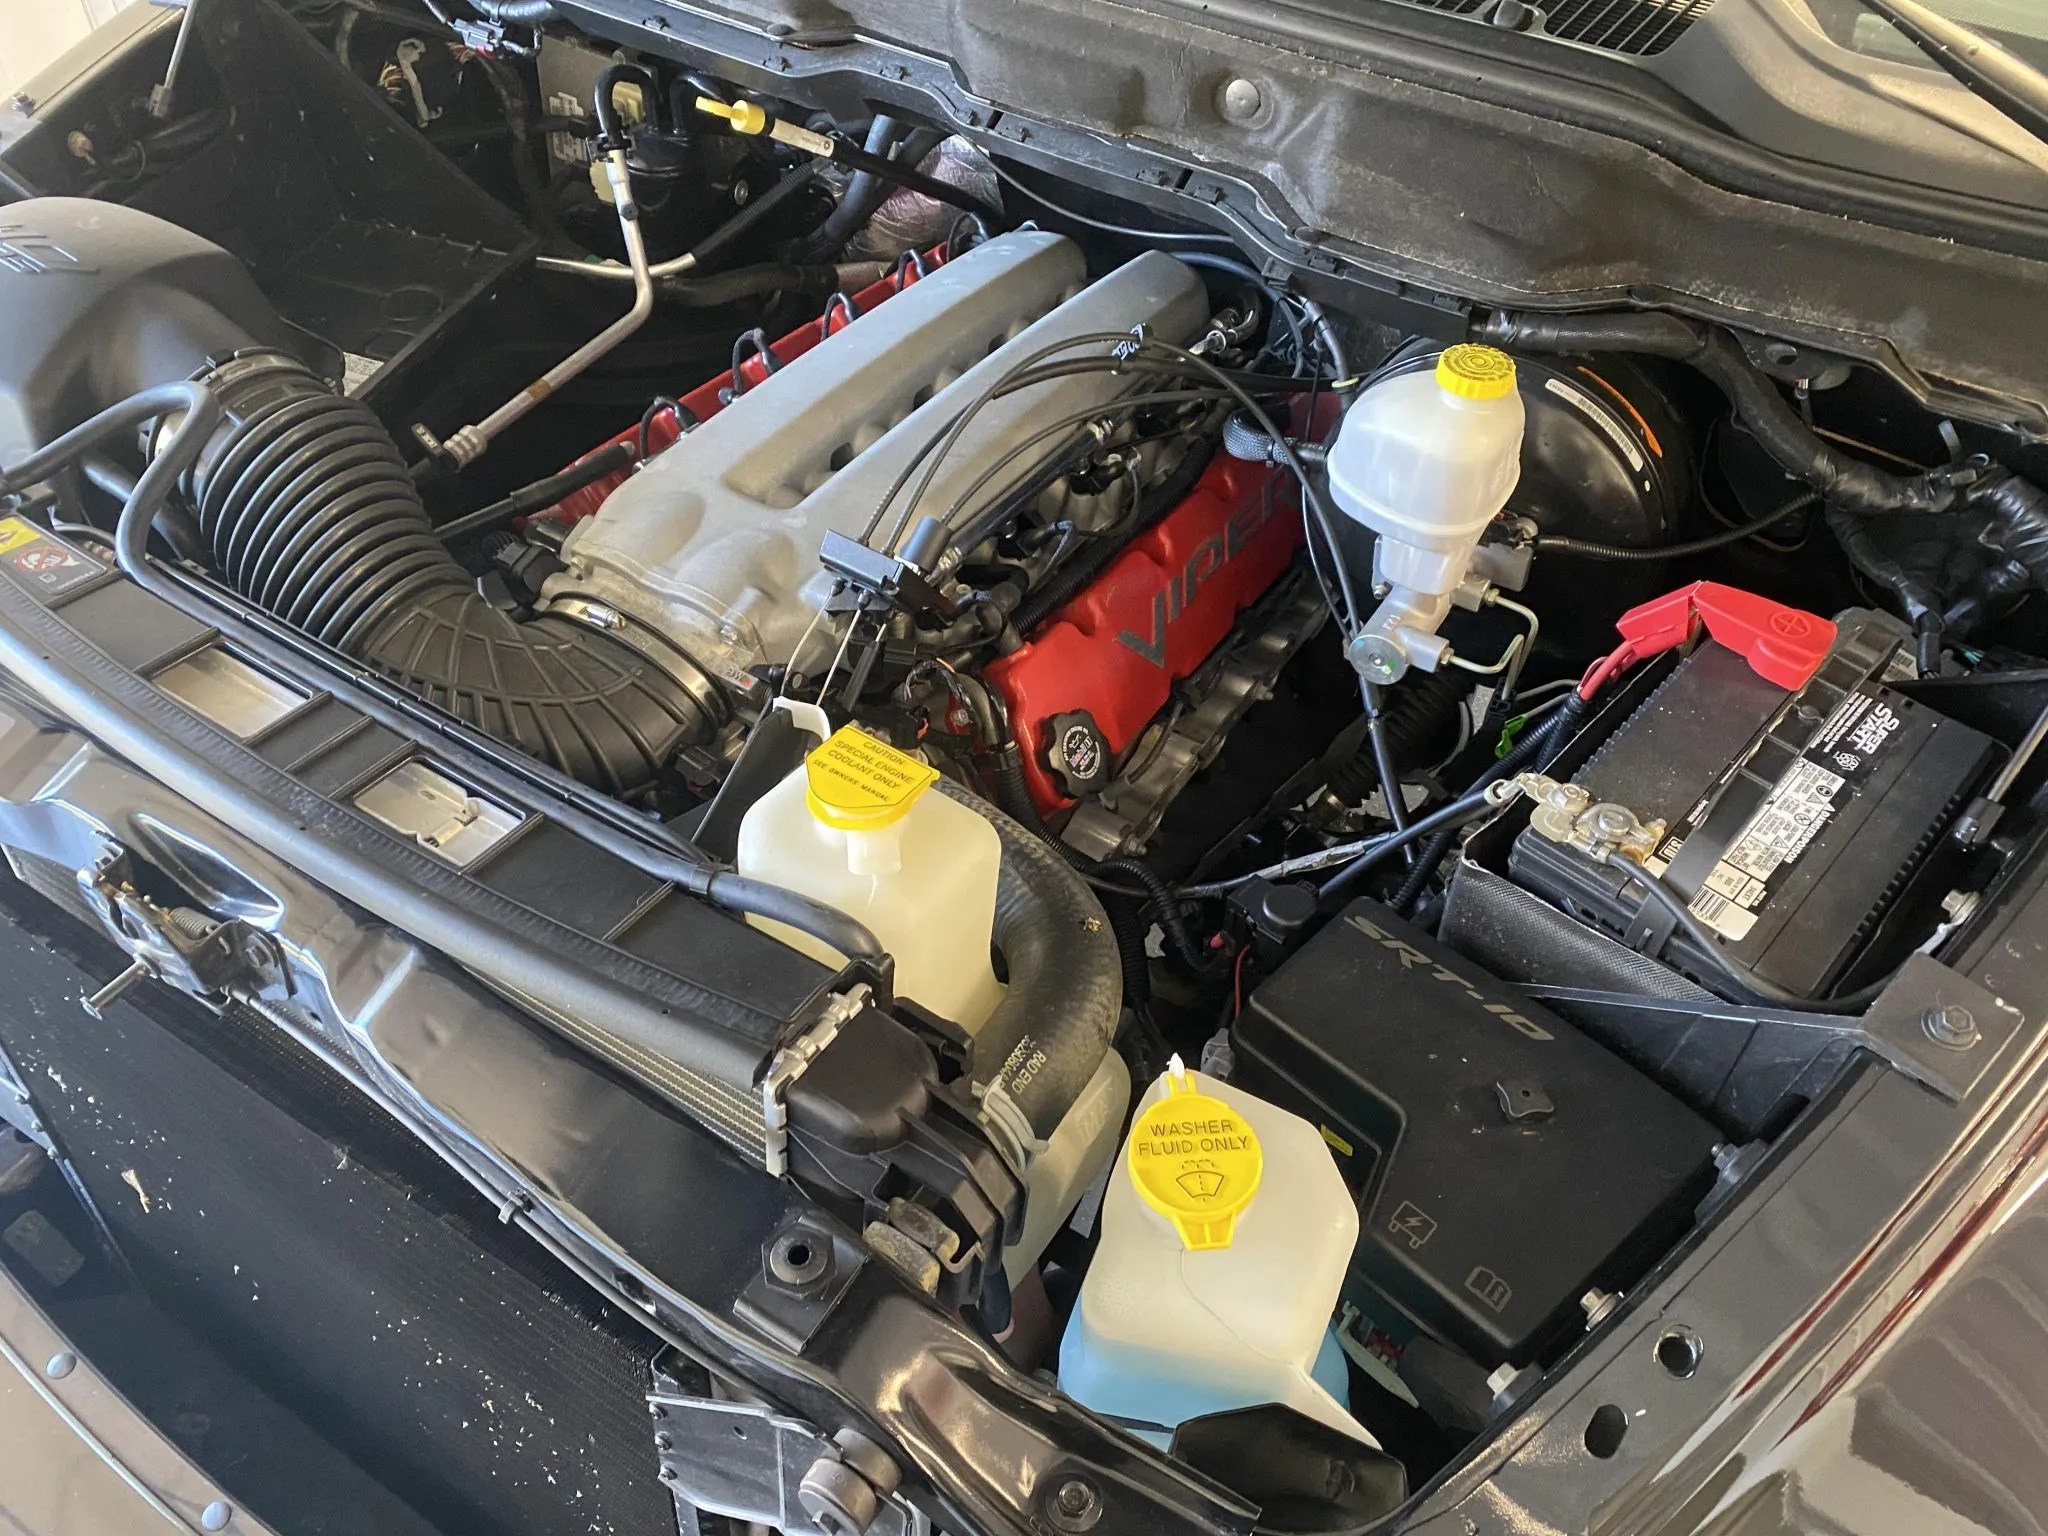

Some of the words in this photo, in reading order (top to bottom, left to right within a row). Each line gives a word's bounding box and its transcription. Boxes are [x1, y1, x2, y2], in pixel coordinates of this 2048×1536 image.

[1112, 464, 1300, 669] VIPER
[1851, 703, 1892, 750] START
[1862, 718, 1900, 754] SUPER
[827, 749, 873, 777] COOLANT
[873, 769, 901, 789] ONLY
[834, 740, 873, 764] SPECIAL
[874, 761, 915, 784] ENGINE
[863, 741, 905, 766] CAUTION
[812, 759, 827, 769] SEE
[860, 784, 890, 802] MANUAL
[1344, 916, 1555, 1040] SRT-10
[1011, 1068, 1032, 1094] END
[1026, 1050, 1047, 1074] RAD
[1138, 1140, 1193, 1156] FLUID
[1200, 1136, 1248, 1152] ONLY
[1150, 1119, 1233, 1136] WASHER
